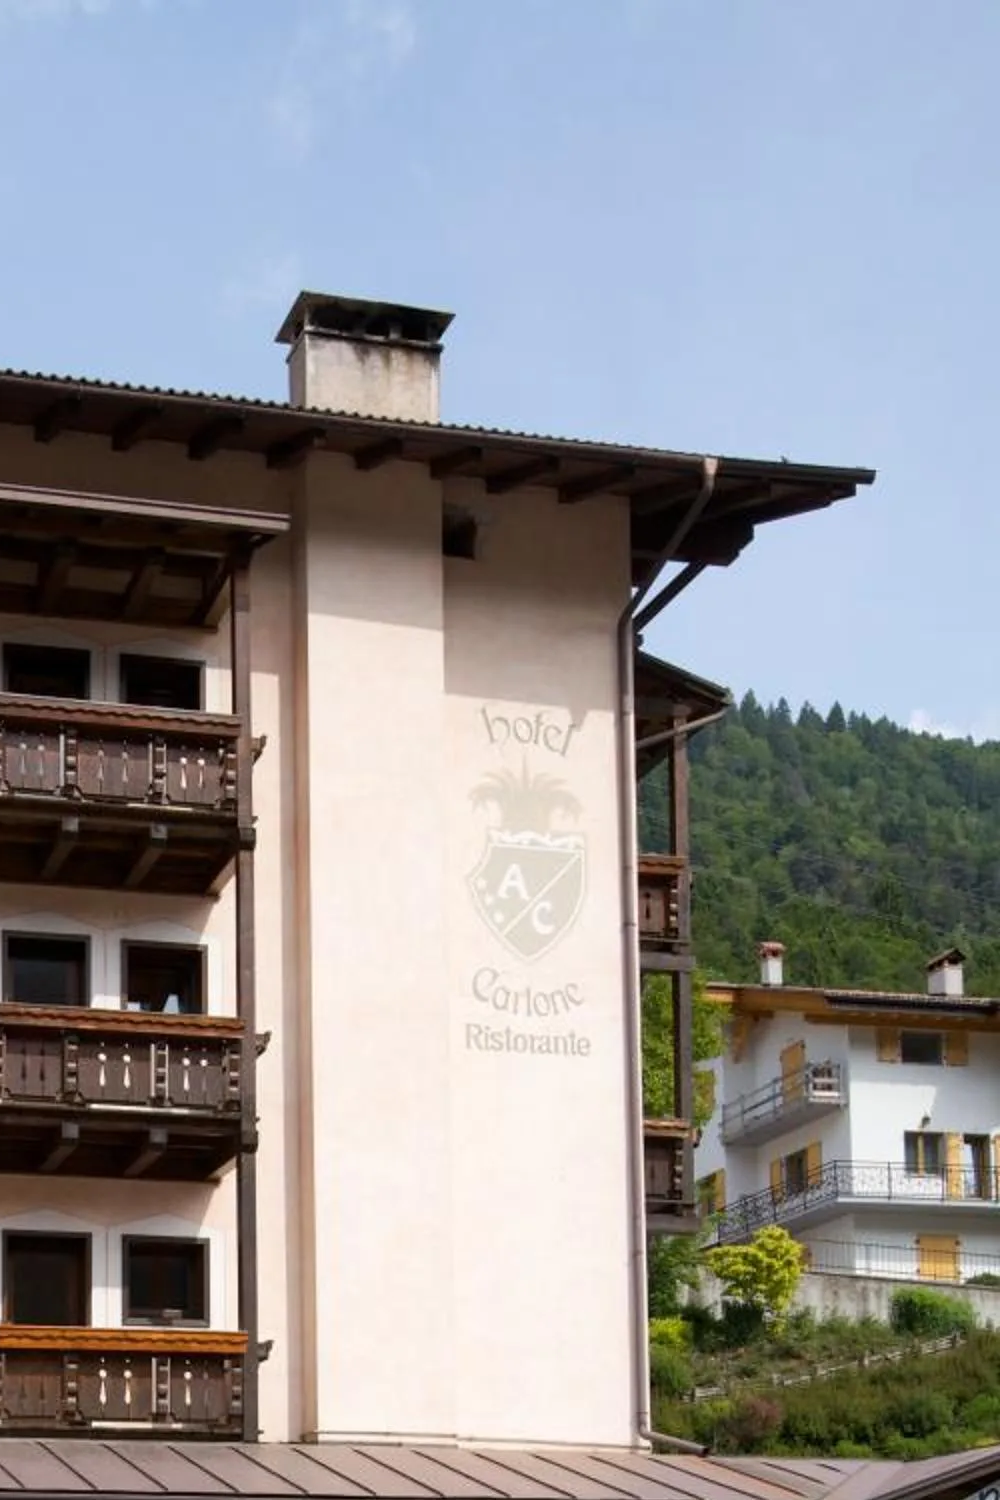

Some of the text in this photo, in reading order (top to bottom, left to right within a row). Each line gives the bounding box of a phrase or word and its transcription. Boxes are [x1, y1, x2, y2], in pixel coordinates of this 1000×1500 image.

[497, 863, 531, 901] A
[530, 901, 556, 936] C
[464, 1022, 592, 1057] Ristorante
